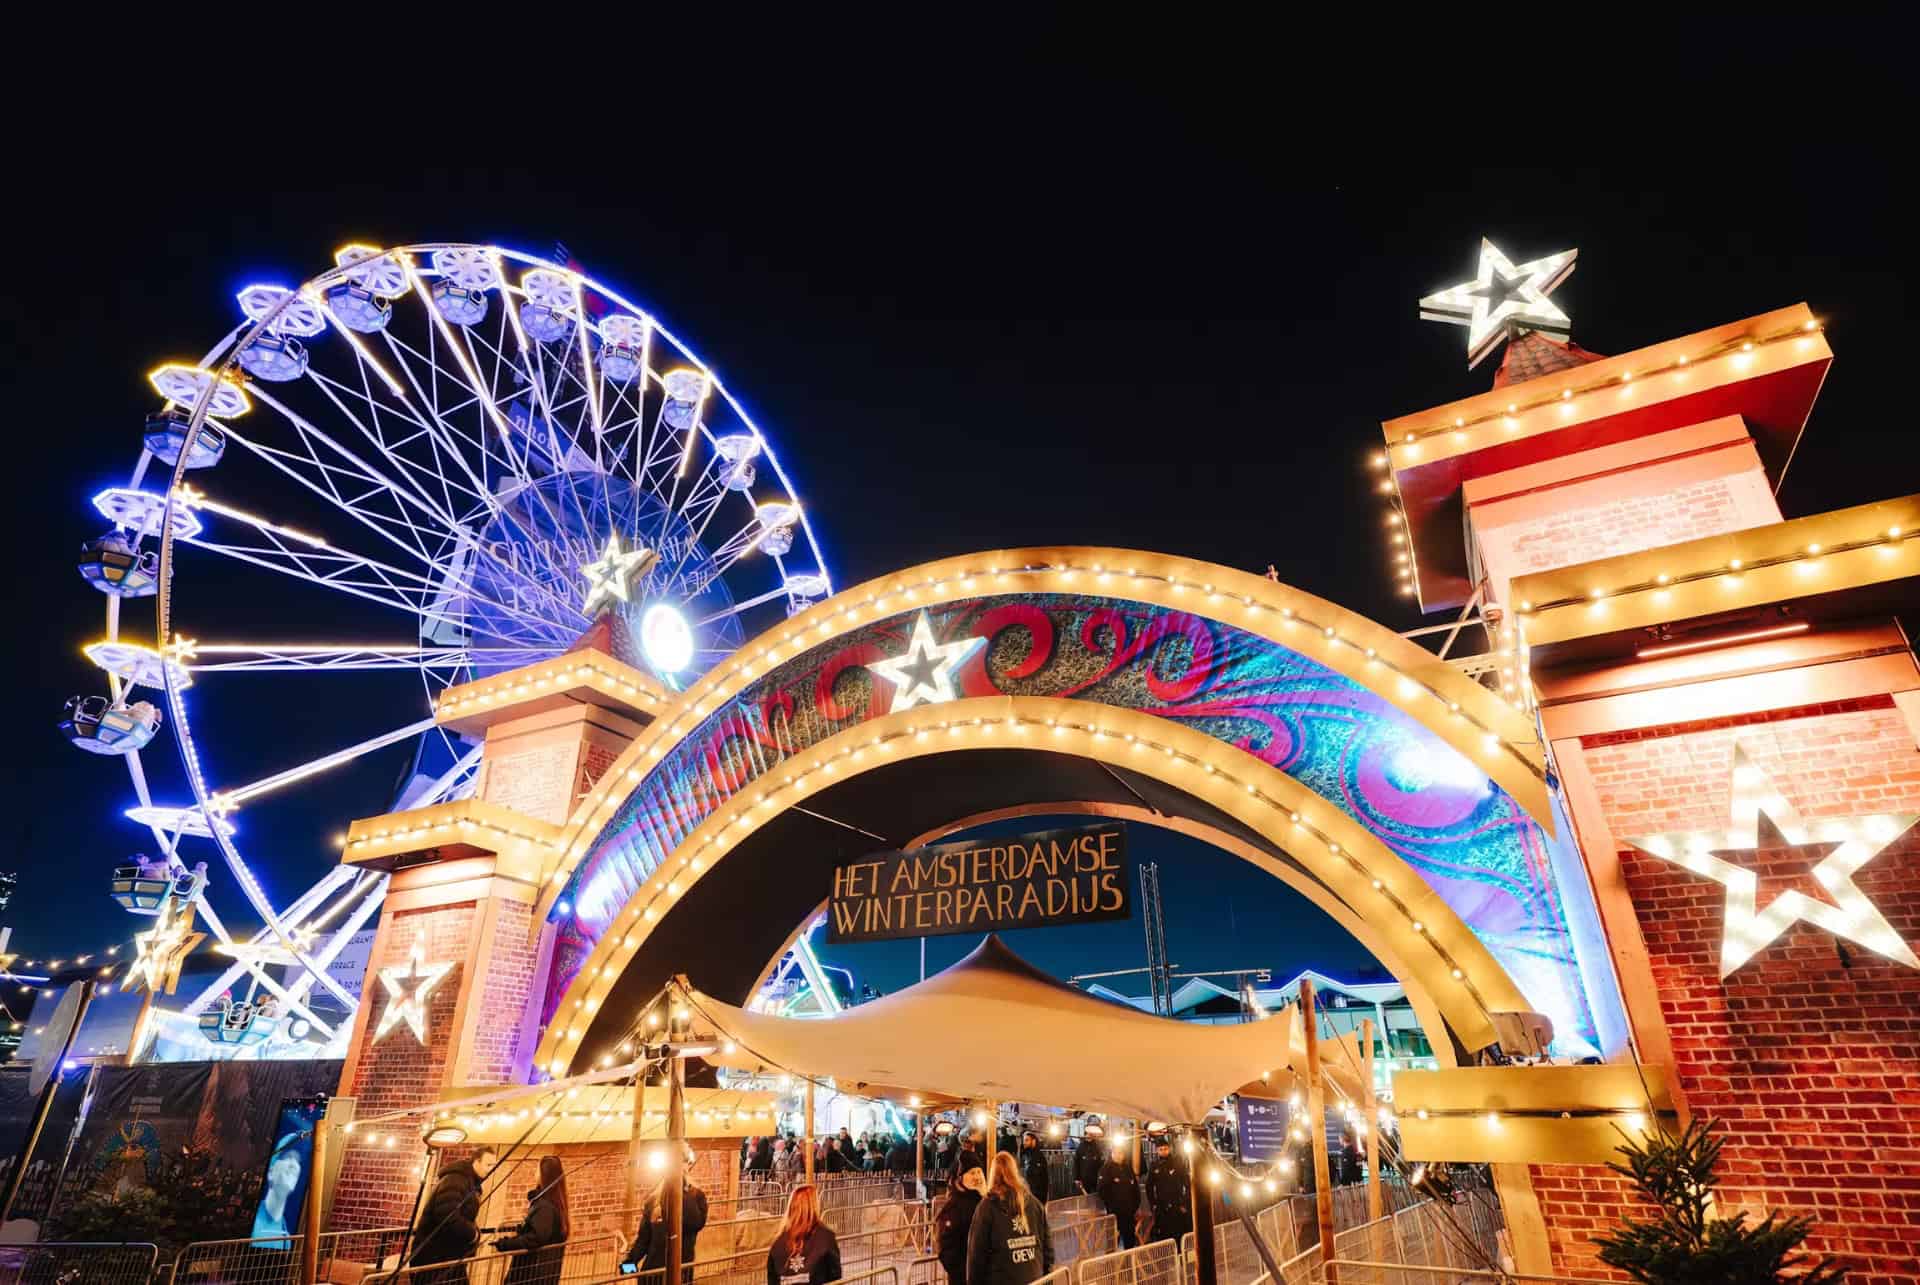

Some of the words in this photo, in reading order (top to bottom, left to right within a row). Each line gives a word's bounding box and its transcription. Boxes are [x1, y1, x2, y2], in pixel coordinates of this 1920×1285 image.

[834, 861, 887, 898] HET
[890, 832, 1121, 893] AMSTERDAMSE
[832, 873, 1124, 936] WINTERPARADIJS
